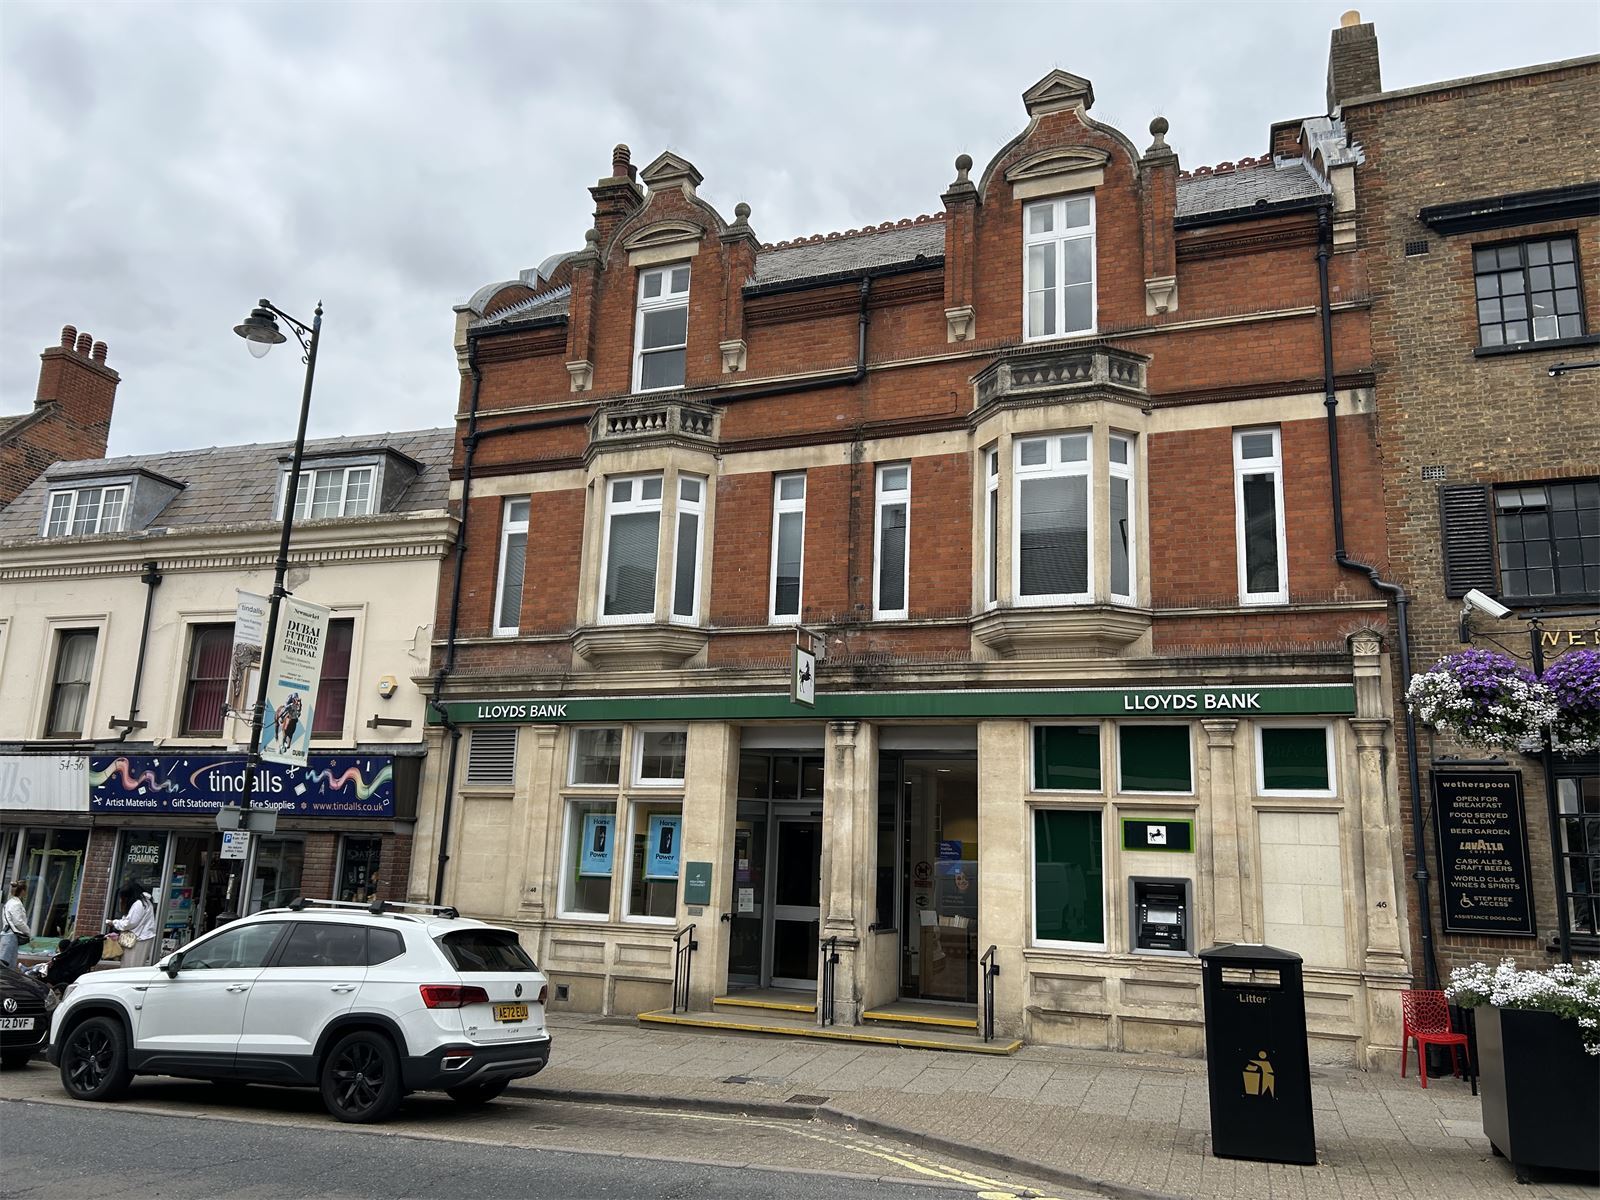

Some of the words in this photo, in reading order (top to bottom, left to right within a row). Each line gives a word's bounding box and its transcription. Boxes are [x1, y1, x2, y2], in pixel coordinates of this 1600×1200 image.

[287, 620, 320, 638] DUBAI
[286, 630, 319, 646] FUTURE
[284, 638, 318, 651] CHAMPIONS
[283, 644, 317, 659] FESTIVAL
[1124, 694, 1198, 710] LLOYDS
[1204, 693, 1261, 709] BANK
[478, 705, 526, 718] LLOYDS
[530, 704, 567, 717] BANK
[59, 760, 84, 771] 54-56
[208, 769, 283, 793] tindalls
[1442, 781, 1510, 789] wetherspoon
[105, 798, 124, 807] Artist
[126, 798, 157, 807] Materials
[172, 798, 186, 808] Gift
[249, 799, 264, 809] fice
[264, 800, 295, 811] Supplies
[312, 802, 383, 811] www.tindalls.co.uk
[130, 845, 159, 854] PICTURE
[1459, 839, 1504, 851] LAVAZZA
[127, 854, 159, 864] FRAMING
[655, 853, 675, 861] Power
[1239, 993, 1268, 1004] Litter
[500, 1006, 516, 1018] AE72
[12, 1018, 30, 1028] DVF
